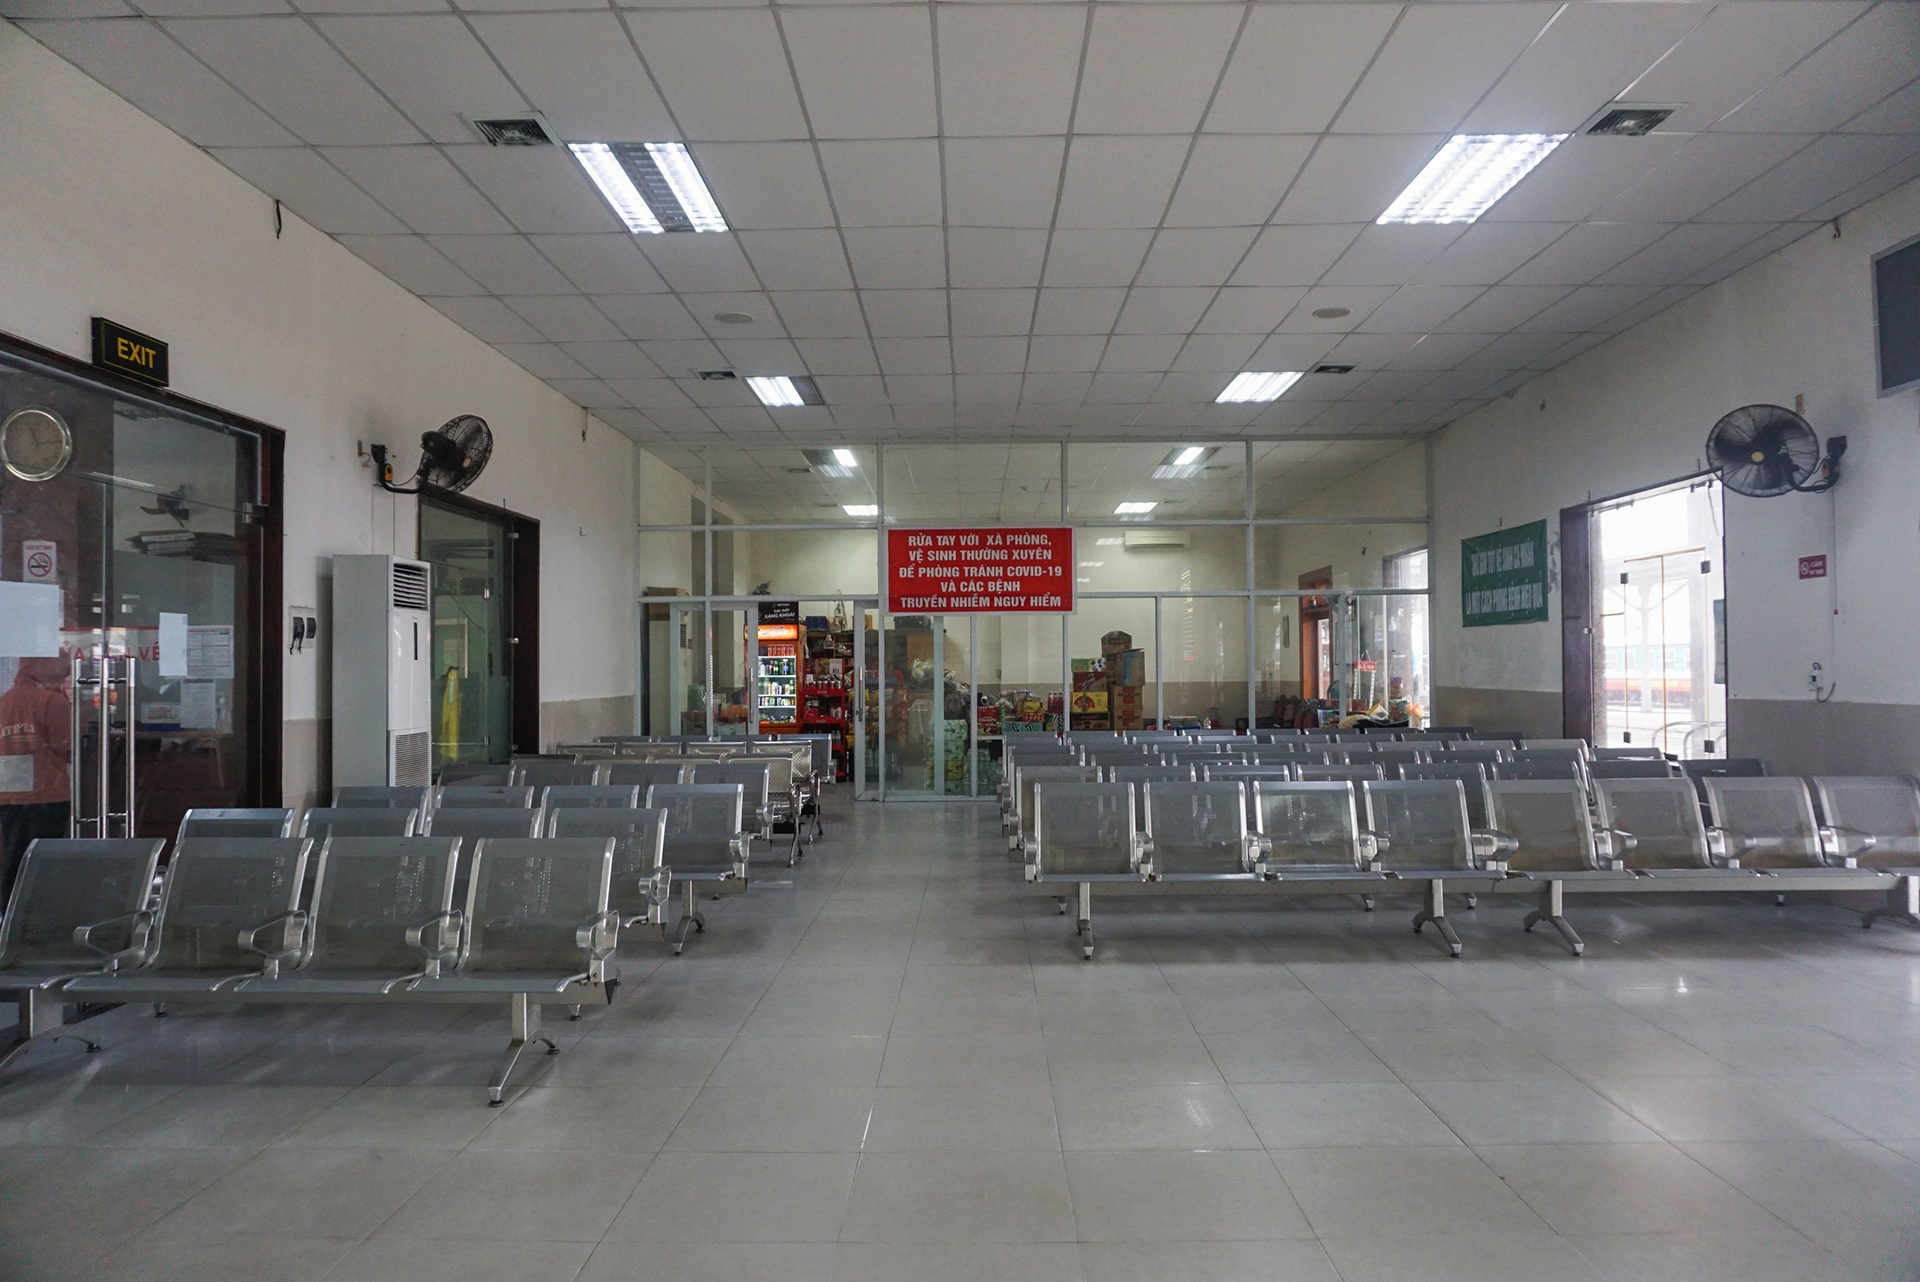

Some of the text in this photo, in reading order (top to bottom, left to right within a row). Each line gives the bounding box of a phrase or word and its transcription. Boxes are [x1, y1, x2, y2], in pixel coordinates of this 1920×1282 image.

[117, 337, 157, 368] EXIT
[908, 532, 1052, 547] RỬA TAY VỚI XÀ PHÒNG,
[909, 547, 1052, 562] VỆ SINH THƯỜNG XUYÊN
[899, 563, 1063, 578] ĐỂ PHÒNG TRÁNH COVID-19
[940, 579, 1021, 594] VÀ CÁC BỆNH
[950, 592, 991, 608] NHIỄM
[993, 596, 1027, 608] NGUY
